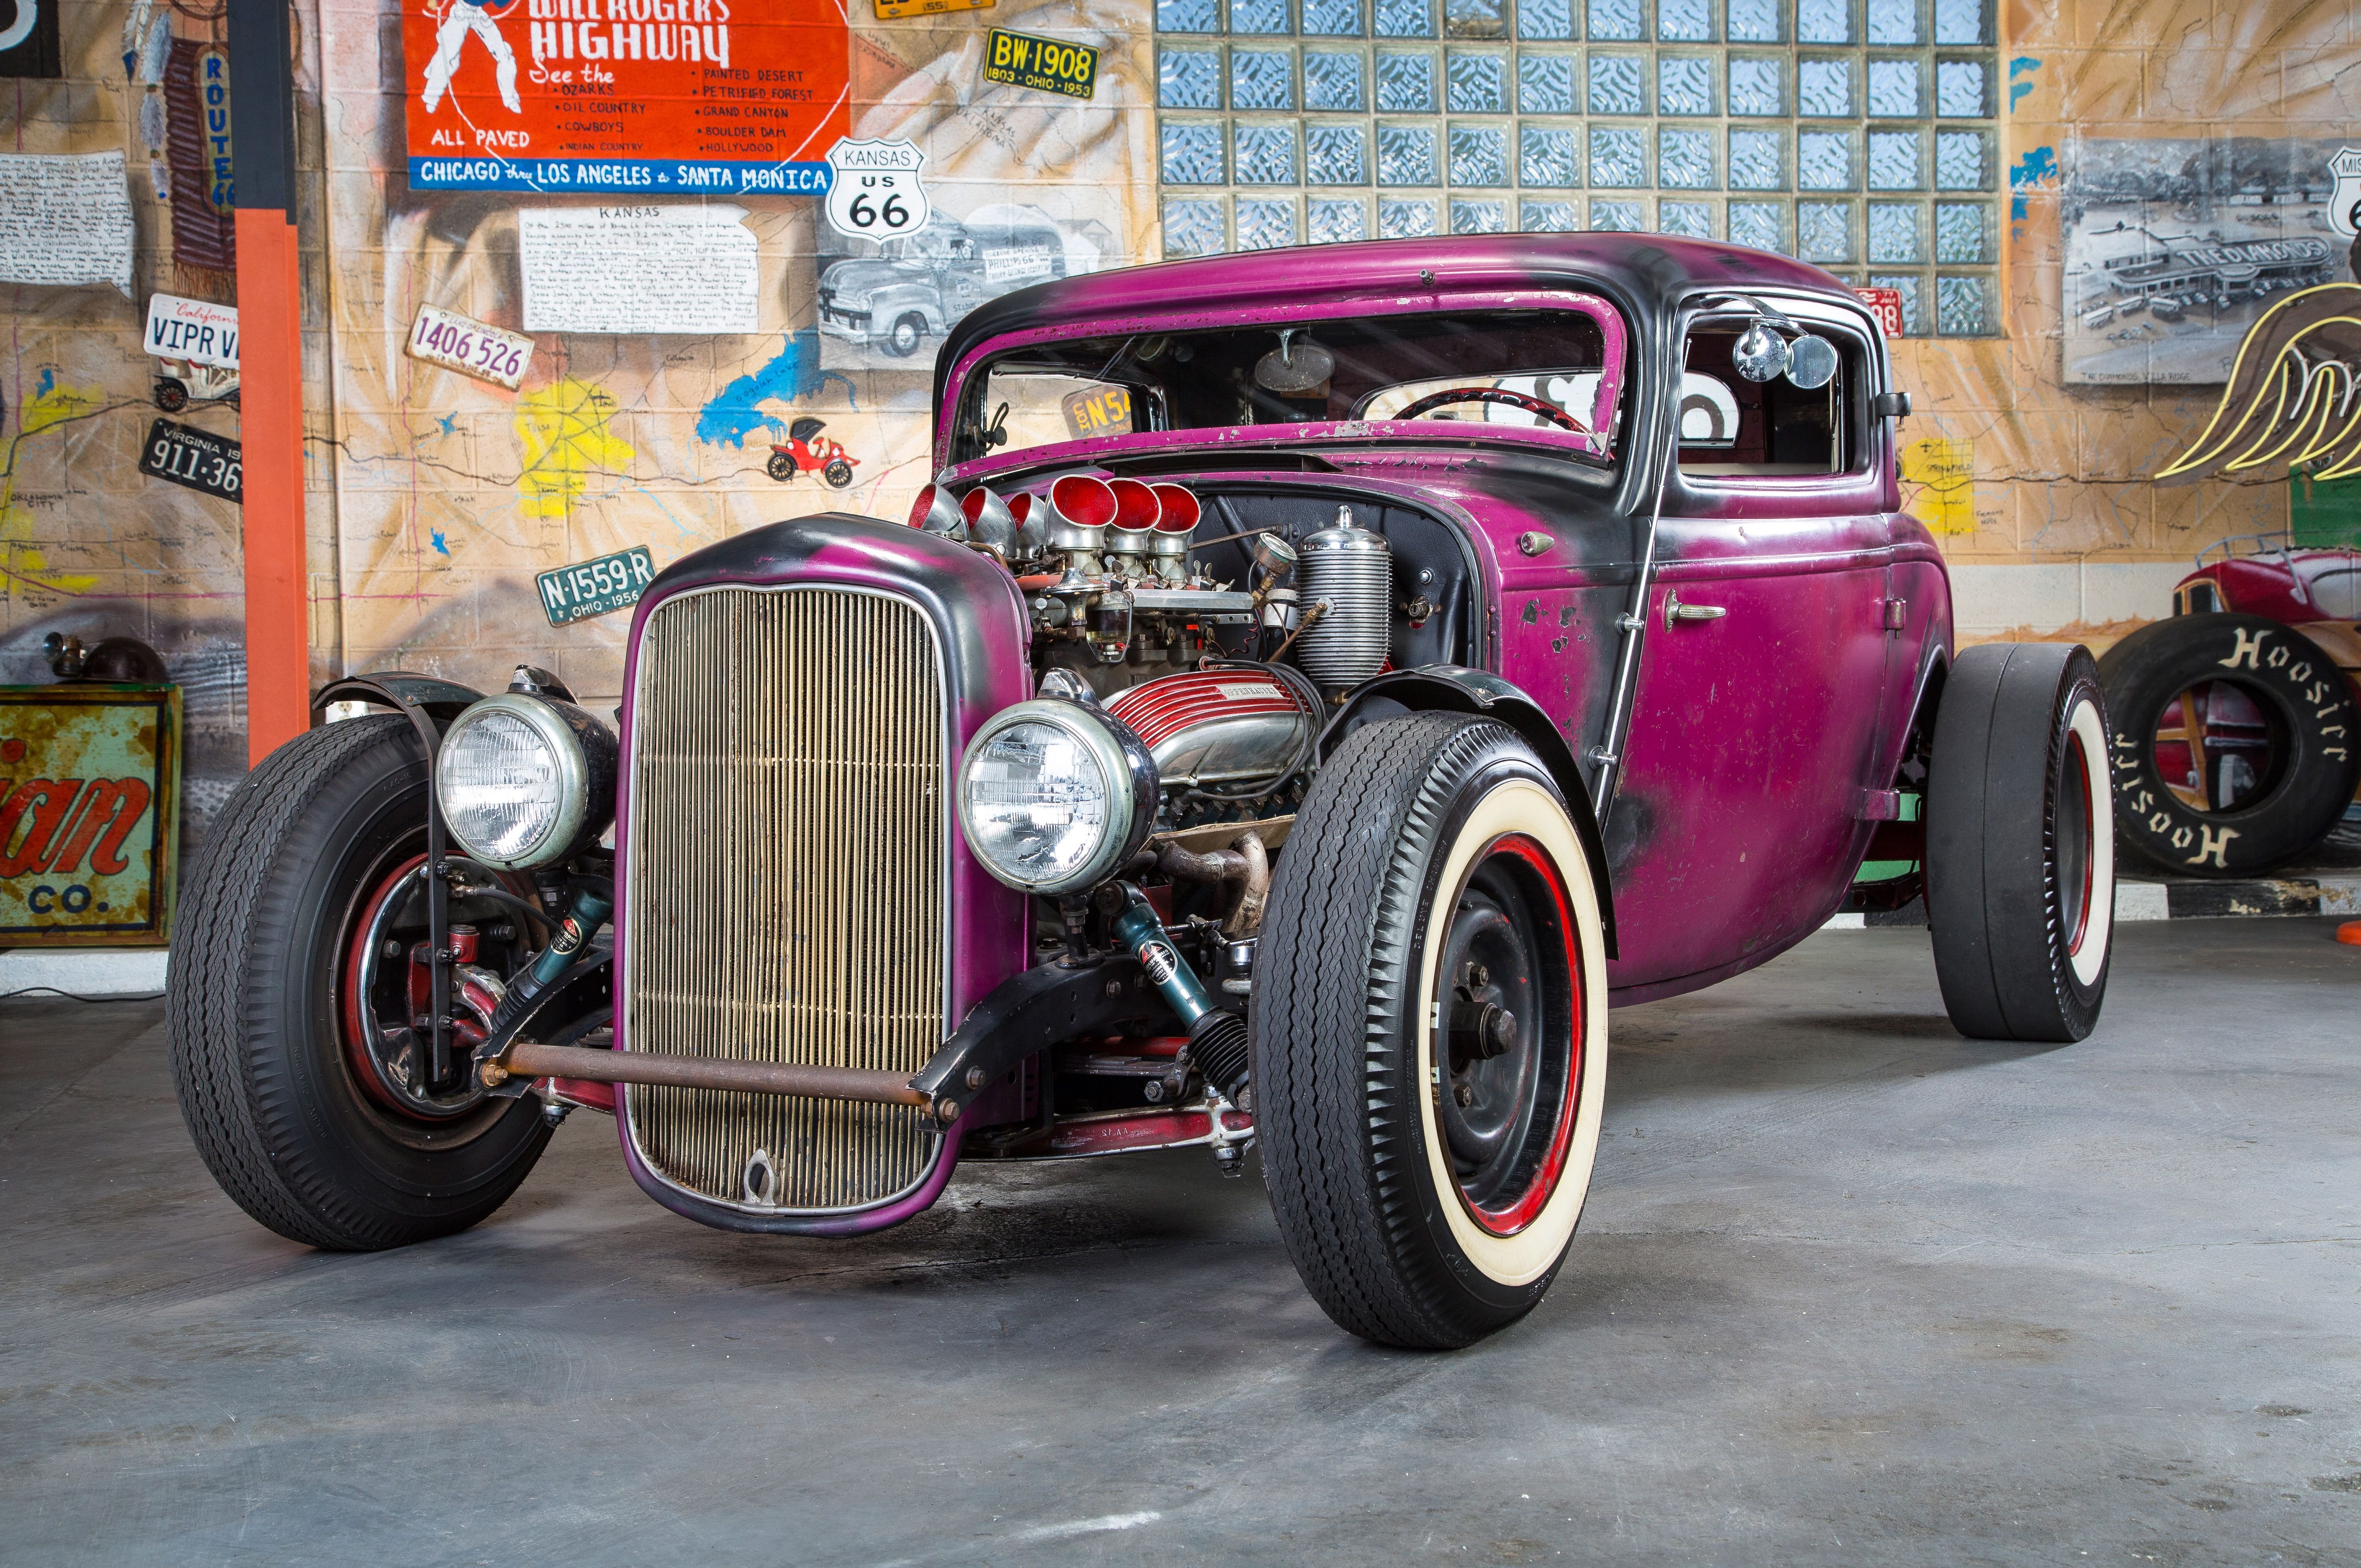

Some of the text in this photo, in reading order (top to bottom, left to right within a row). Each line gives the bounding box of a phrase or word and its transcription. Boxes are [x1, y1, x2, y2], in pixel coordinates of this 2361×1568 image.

[530, 21, 730, 68] HIGHWAY
[529, 52, 614, 83] See the
[704, 68, 804, 82] PAINTED DESERT
[988, 67, 1090, 97] 1803 OHIO 1953
[562, 82, 614, 96] OZARKS
[703, 86, 813, 100] PETRIFIED FOREST
[563, 102, 645, 114] OIL COUNTRY
[703, 106, 788, 118] GRAND CANYON
[565, 122, 623, 132] COWBOYS
[706, 127, 786, 137] BOULDER DAM
[431, 129, 530, 147] ALL PAVED
[600, 142, 643, 150] COUNTRY
[706, 143, 773, 152] HOLLYWOOD
[845, 150, 910, 166] KANSAS
[421, 162, 500, 181] CHICAGO
[537, 163, 571, 183] LOS
[576, 164, 651, 185] ANGELES
[677, 165, 733, 187] SANTA
[742, 168, 827, 189] MONICA
[862, 176, 894, 187] US
[600, 207, 660, 218] KANSAS
[849, 193, 909, 228] 66
[177, 303, 239, 324] Californi
[154, 317, 214, 355] VIPR
[416, 317, 522, 376] 1406 526
[164, 428, 221, 454] VIRGINIA
[10, 493, 63, 502] OKLAHOMA
[27, 501, 55, 511] CITY
[572, 589, 639, 617] OHIO 1956
[1224, 687, 1280, 697] OFFENHAUSER
[28, 884, 109, 914] CO.
